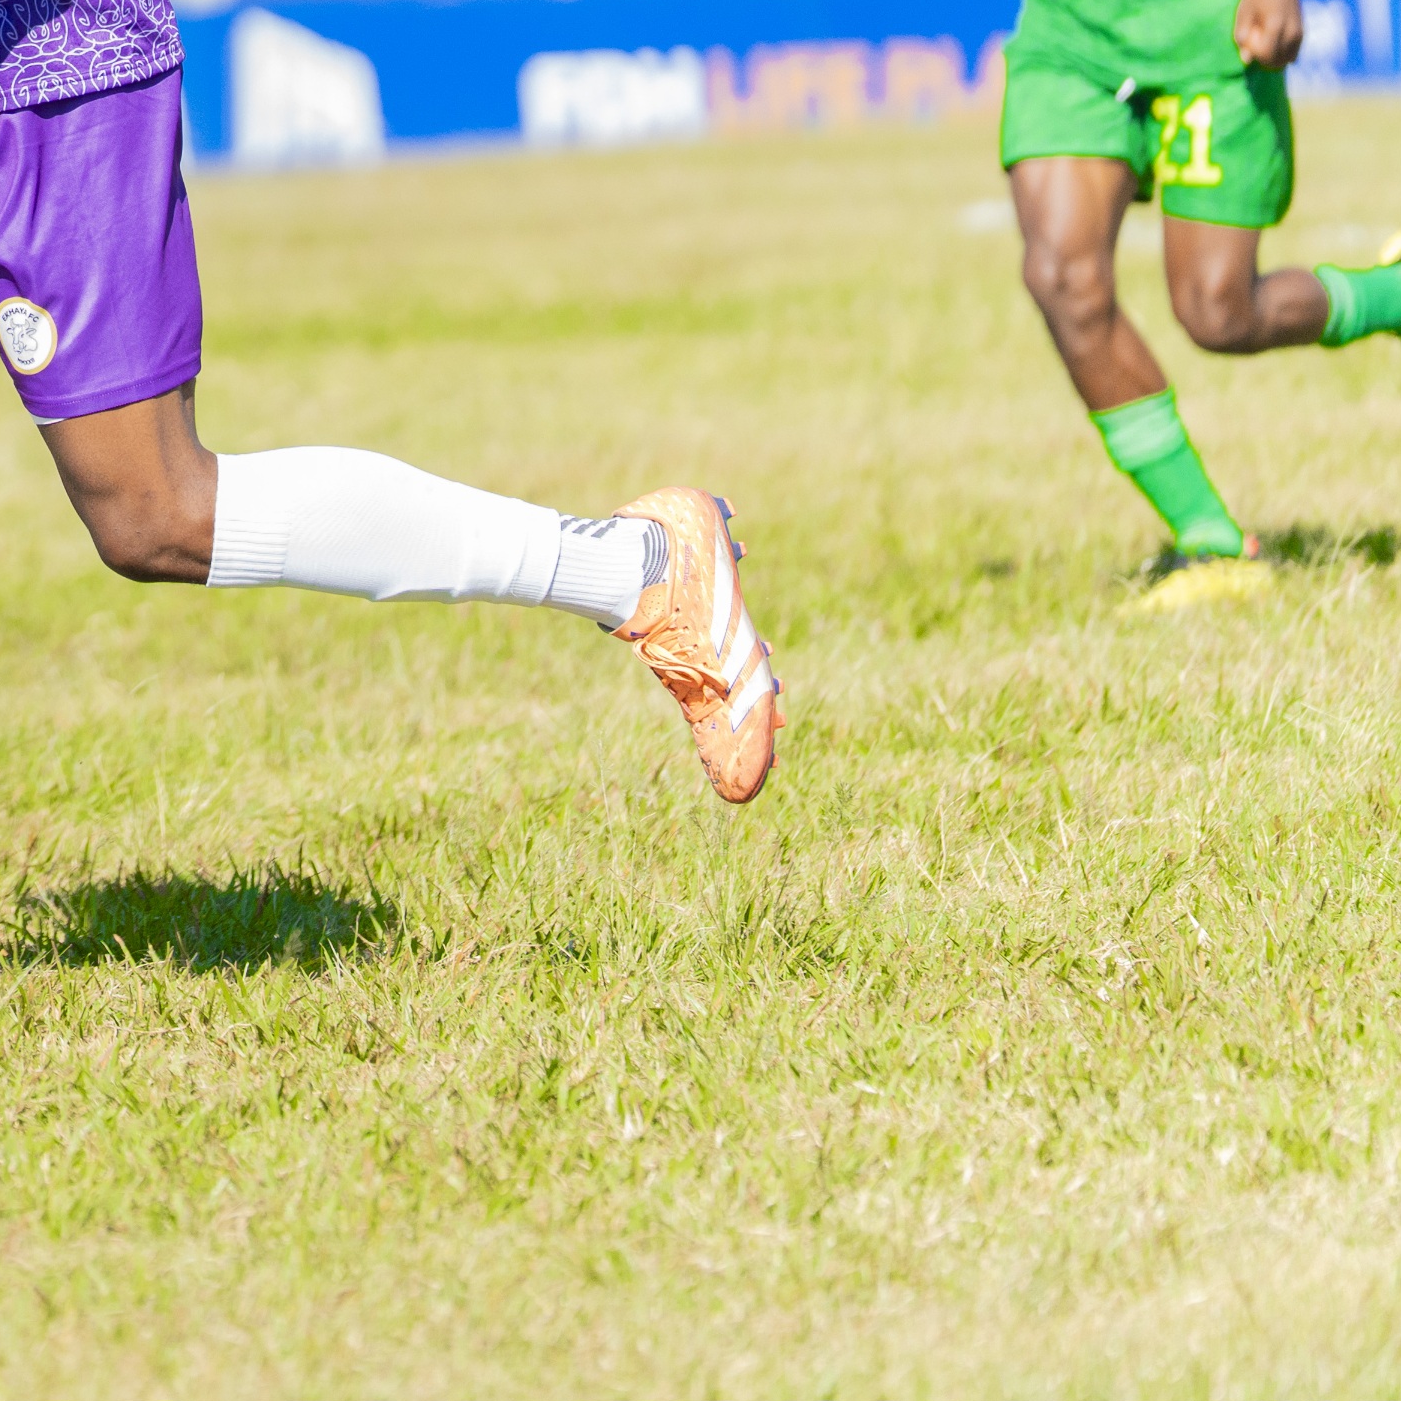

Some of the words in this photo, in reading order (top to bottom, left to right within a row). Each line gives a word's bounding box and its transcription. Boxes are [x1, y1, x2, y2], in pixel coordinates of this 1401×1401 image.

[1151, 94, 1222, 186] 21
[1, 307, 28, 322] EKHAYA
[28, 312, 40, 323] FC
